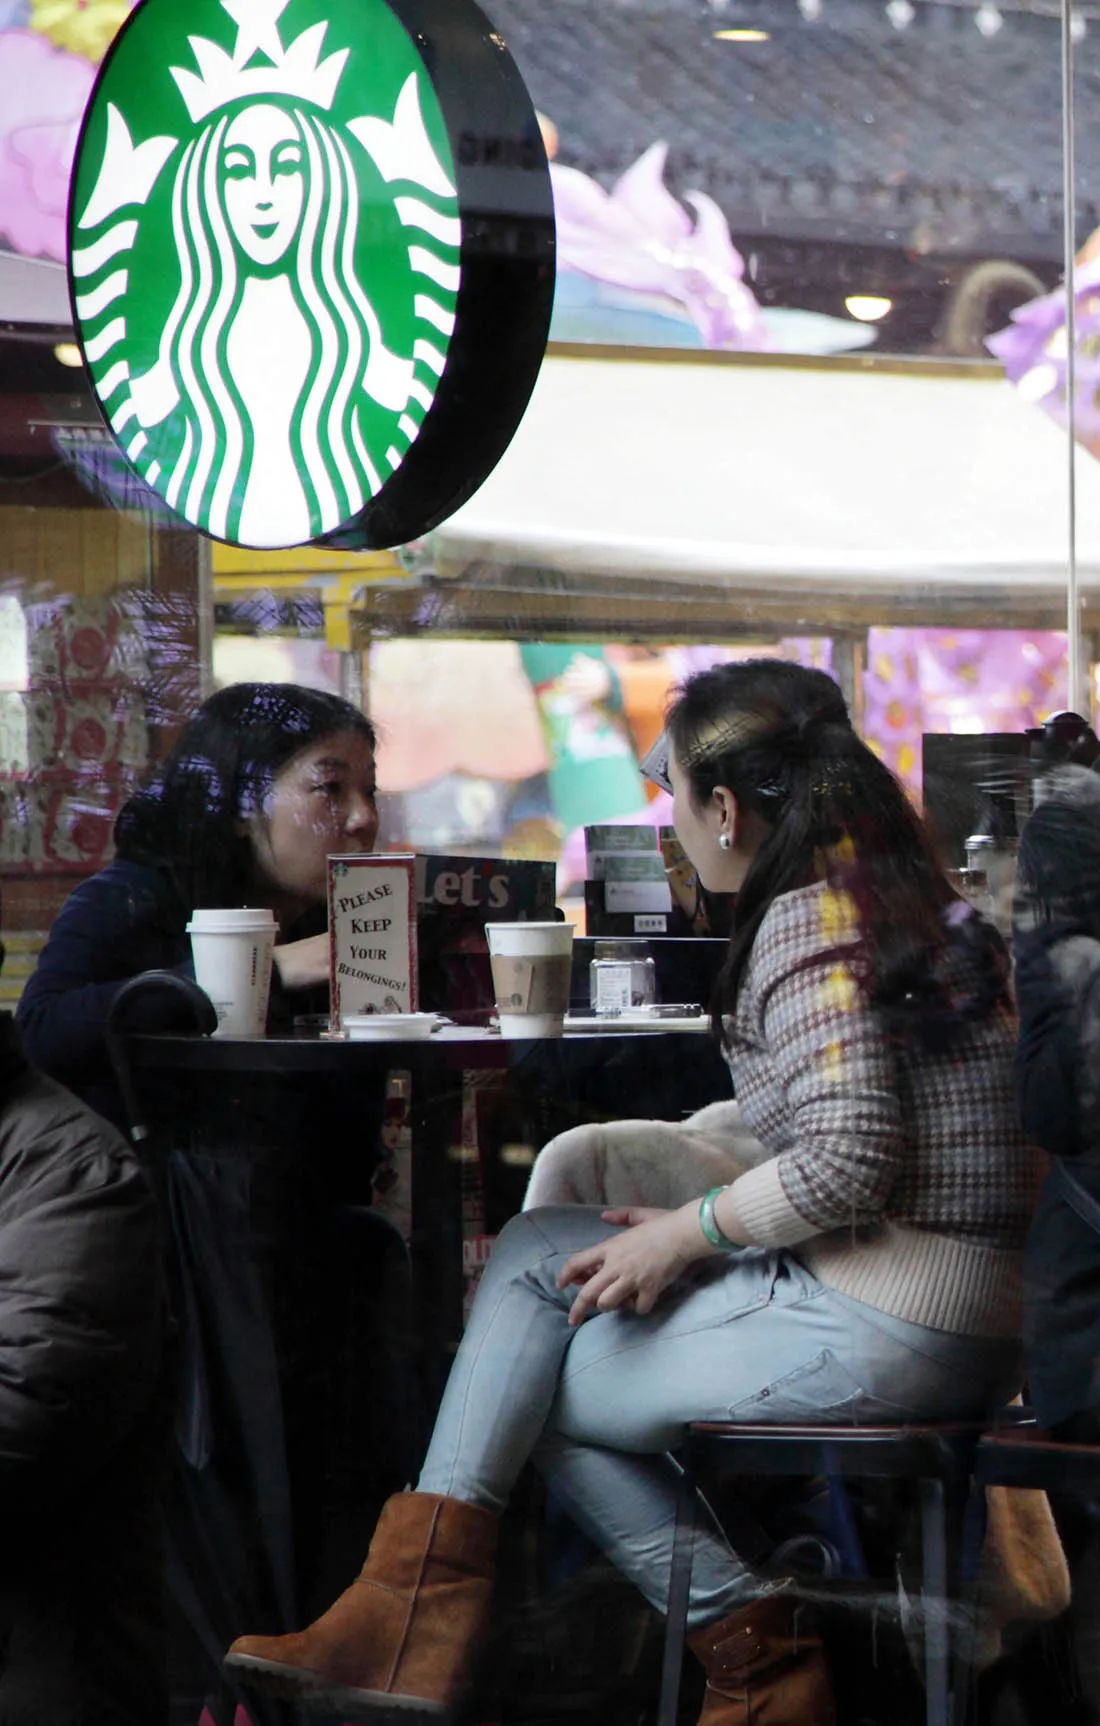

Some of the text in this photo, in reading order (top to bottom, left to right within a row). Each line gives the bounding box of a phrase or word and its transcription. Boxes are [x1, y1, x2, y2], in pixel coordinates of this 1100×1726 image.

[413, 857, 510, 908] Let's
[339, 884, 393, 912] PLEASE
[352, 918, 392, 934] KEEP
[350, 945, 387, 960] YOUR
[338, 962, 407, 991] BELONGINGS!
